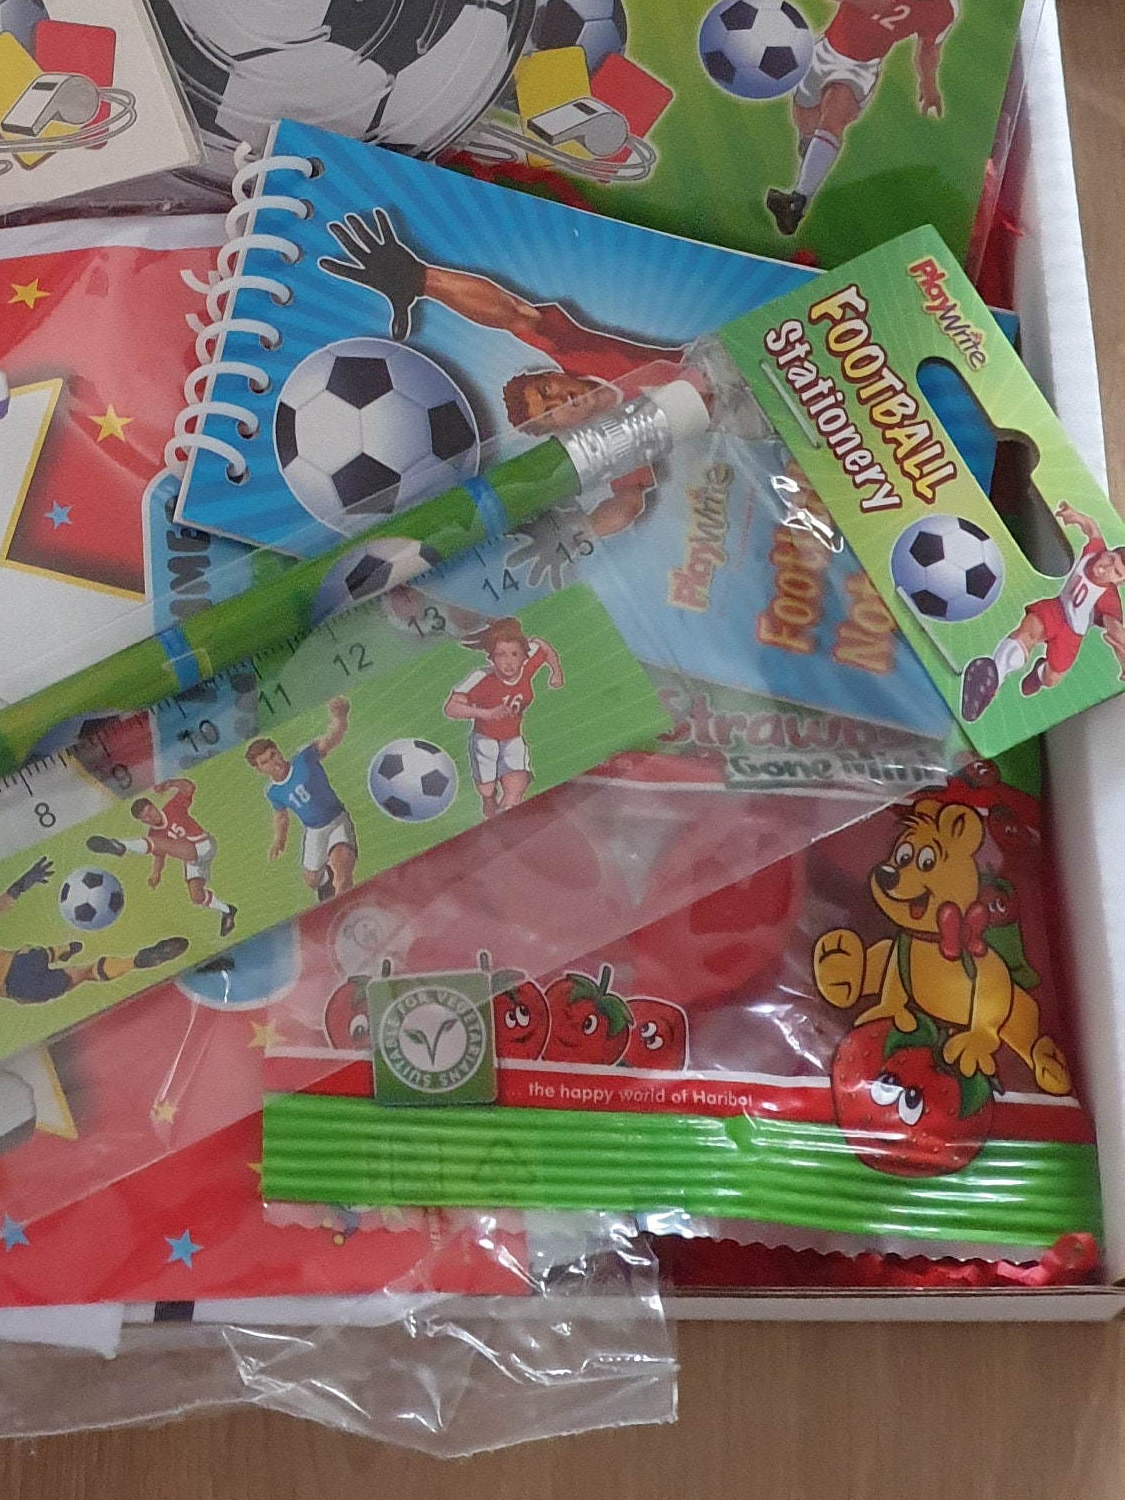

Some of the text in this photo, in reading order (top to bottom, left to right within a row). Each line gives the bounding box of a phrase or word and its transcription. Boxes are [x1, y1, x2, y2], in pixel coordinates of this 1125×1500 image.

[908, 258, 987, 370] PlayWrite
[764, 320, 901, 513] Stationery
[809, 285, 956, 503] FOOTBALL
[34, 802, 56, 828] 8
[331, 642, 373, 677] 12
[407, 606, 446, 639] 13
[481, 568, 520, 601] 14
[555, 530, 594, 565] 15
[289, 783, 311, 808] 18
[727, 753, 833, 780] Gone
[528, 1081, 555, 1098] the
[559, 1083, 614, 1105] happy
[618, 1087, 666, 1103] world
[671, 1090, 688, 1104] of
